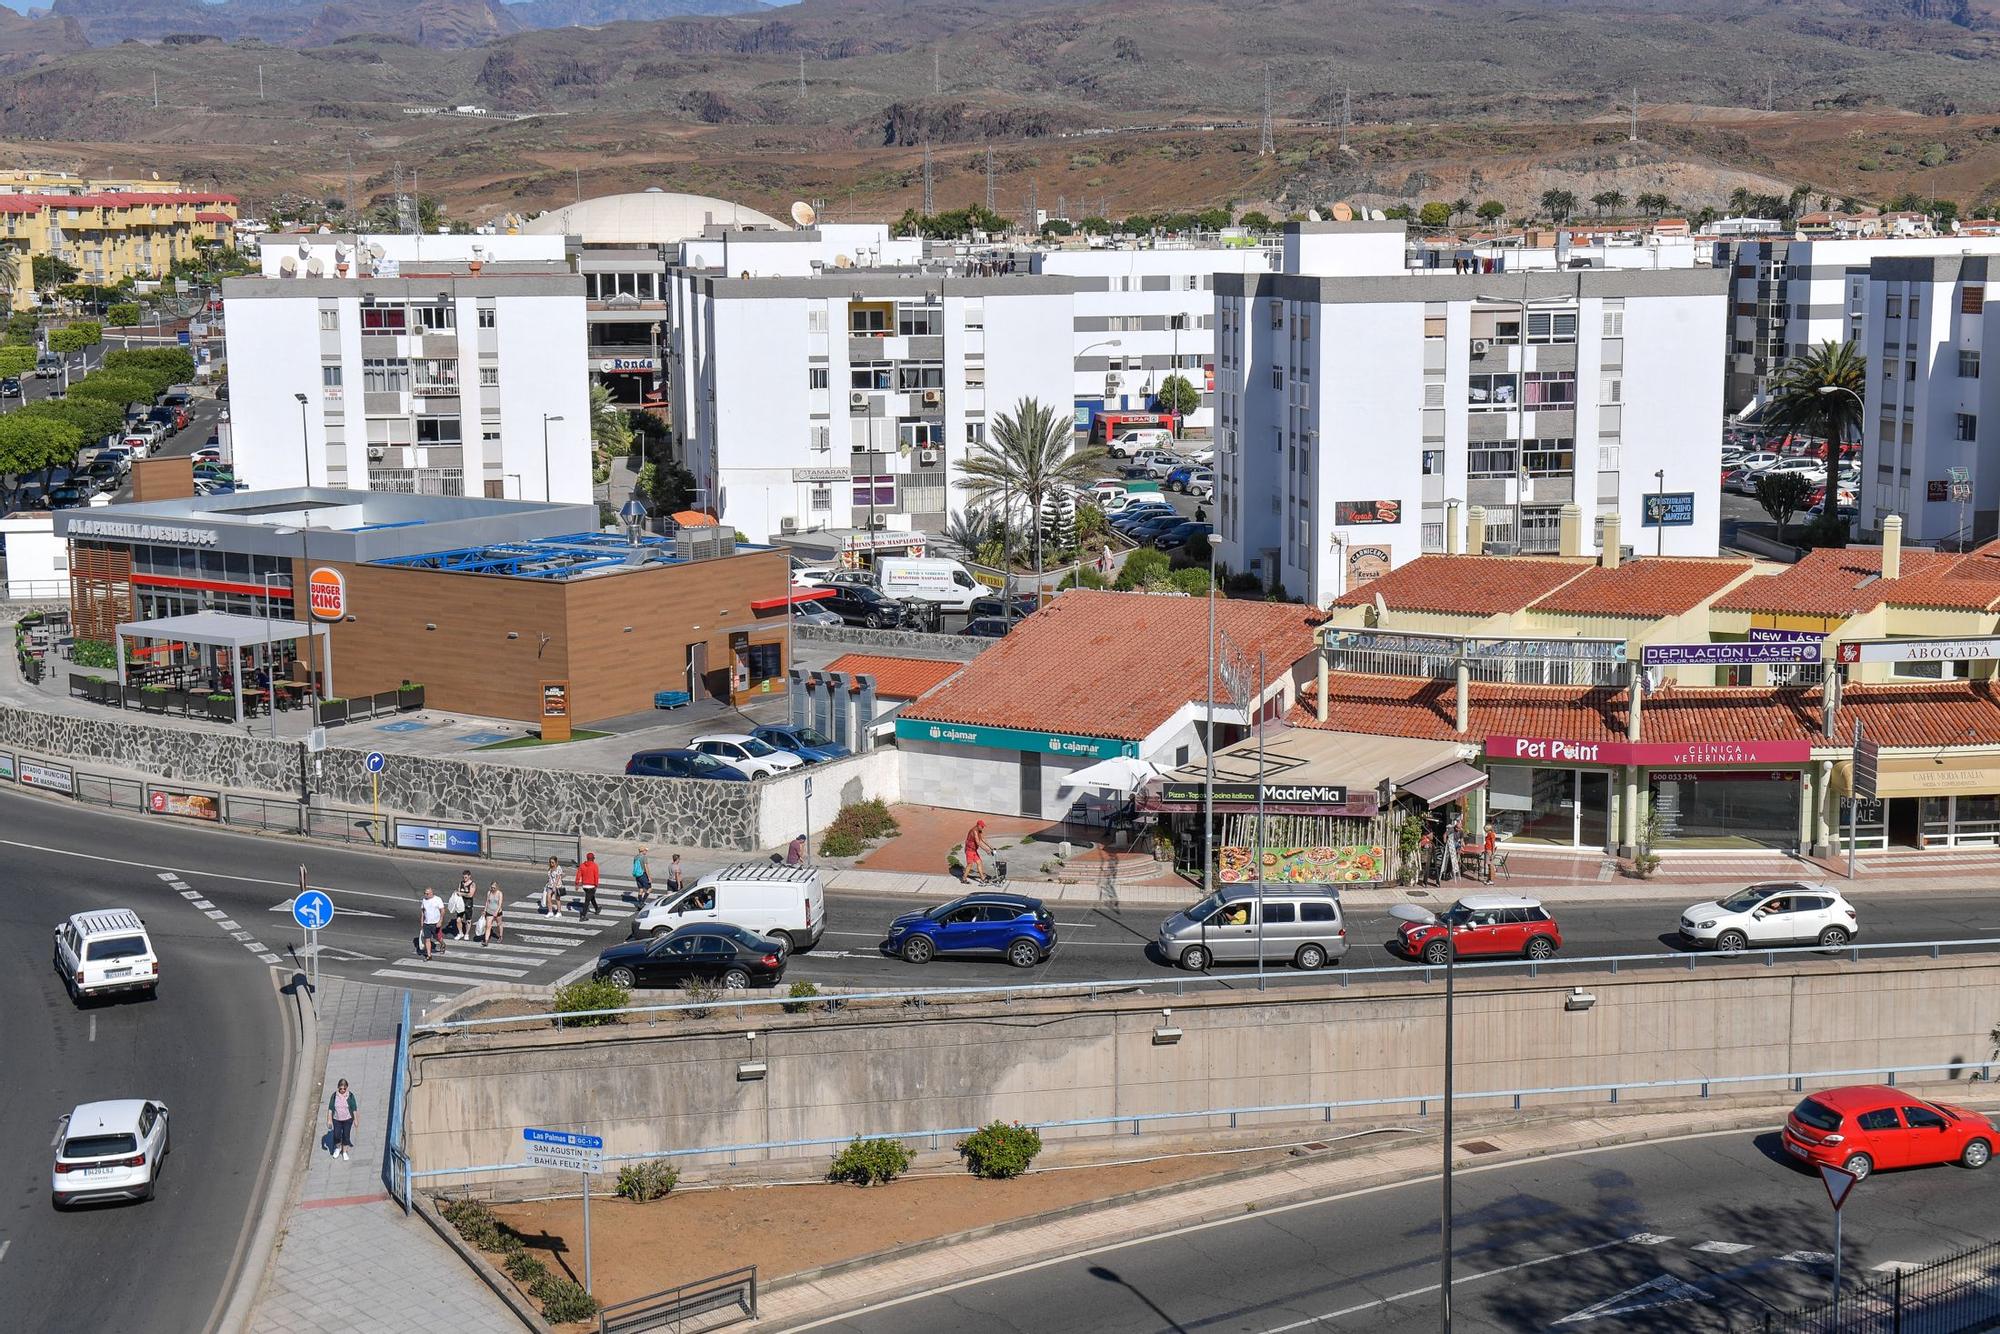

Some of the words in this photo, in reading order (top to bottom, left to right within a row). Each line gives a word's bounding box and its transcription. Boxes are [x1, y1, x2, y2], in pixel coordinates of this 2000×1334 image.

[614, 358, 653, 369] Ronda
[1671, 504, 1691, 512] CHINO
[311, 583, 341, 595] BURGER
[311, 594, 341, 609] KING
[1752, 631, 1782, 641] NEW
[1647, 645, 1745, 659] DEPILACIÓN
[1748, 644, 1802, 657] LÁSER
[1907, 646, 1990, 659] ABOGADA
[942, 728, 977, 741] cajamar
[1062, 741, 1100, 753] cajamar
[1516, 739, 1546, 758] Pet
[1551, 740, 1599, 761] Point
[1688, 743, 1742, 754] CLÍNICA
[1673, 753, 1757, 763] VETERINARIA
[21, 764, 42, 775] ESTADIO
[43, 769, 70, 781] MUNICIPAL
[33, 776, 40, 784] DE
[40, 779, 72, 790] MASPALOMAS
[1262, 785, 1340, 801] MadreMia
[533, 1131, 544, 1140] Las
[544, 1132, 566, 1143] Palmas
[533, 1144, 549, 1152] SAN
[559, 1159, 581, 1169] FELIZ
